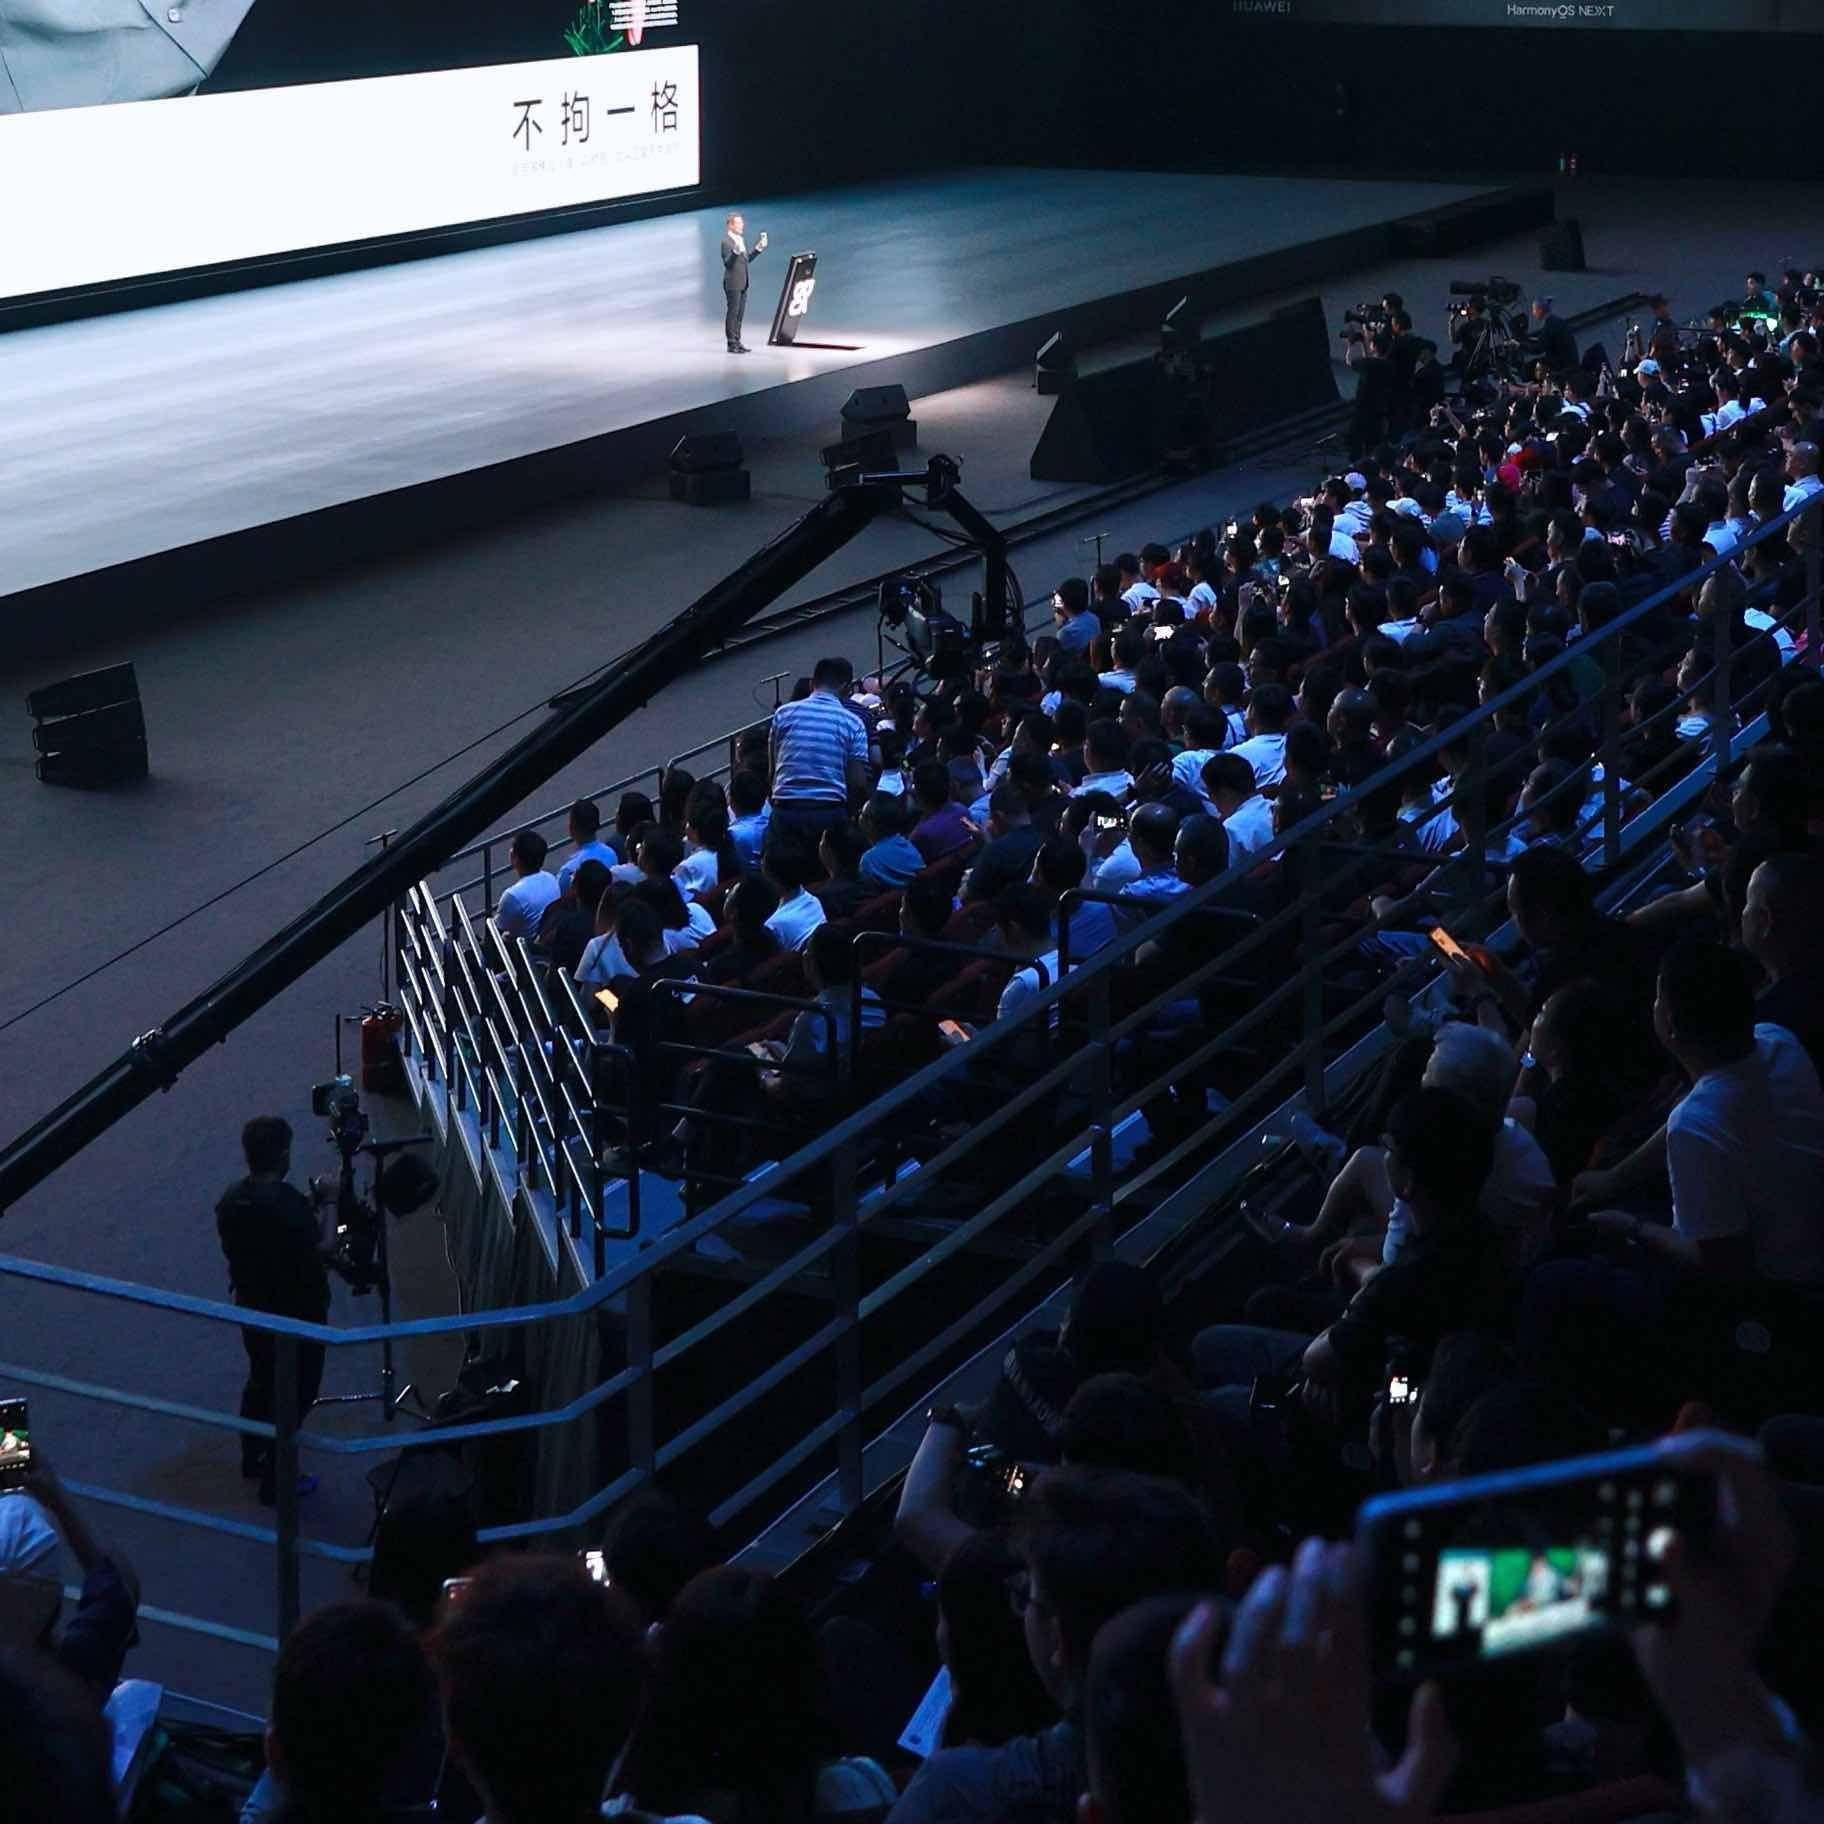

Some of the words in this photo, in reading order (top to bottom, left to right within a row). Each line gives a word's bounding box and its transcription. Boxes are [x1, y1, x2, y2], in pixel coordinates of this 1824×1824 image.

[1507, 4, 1576, 19] HarmonyOS
[513, 80, 679, 152] 不拘一格
